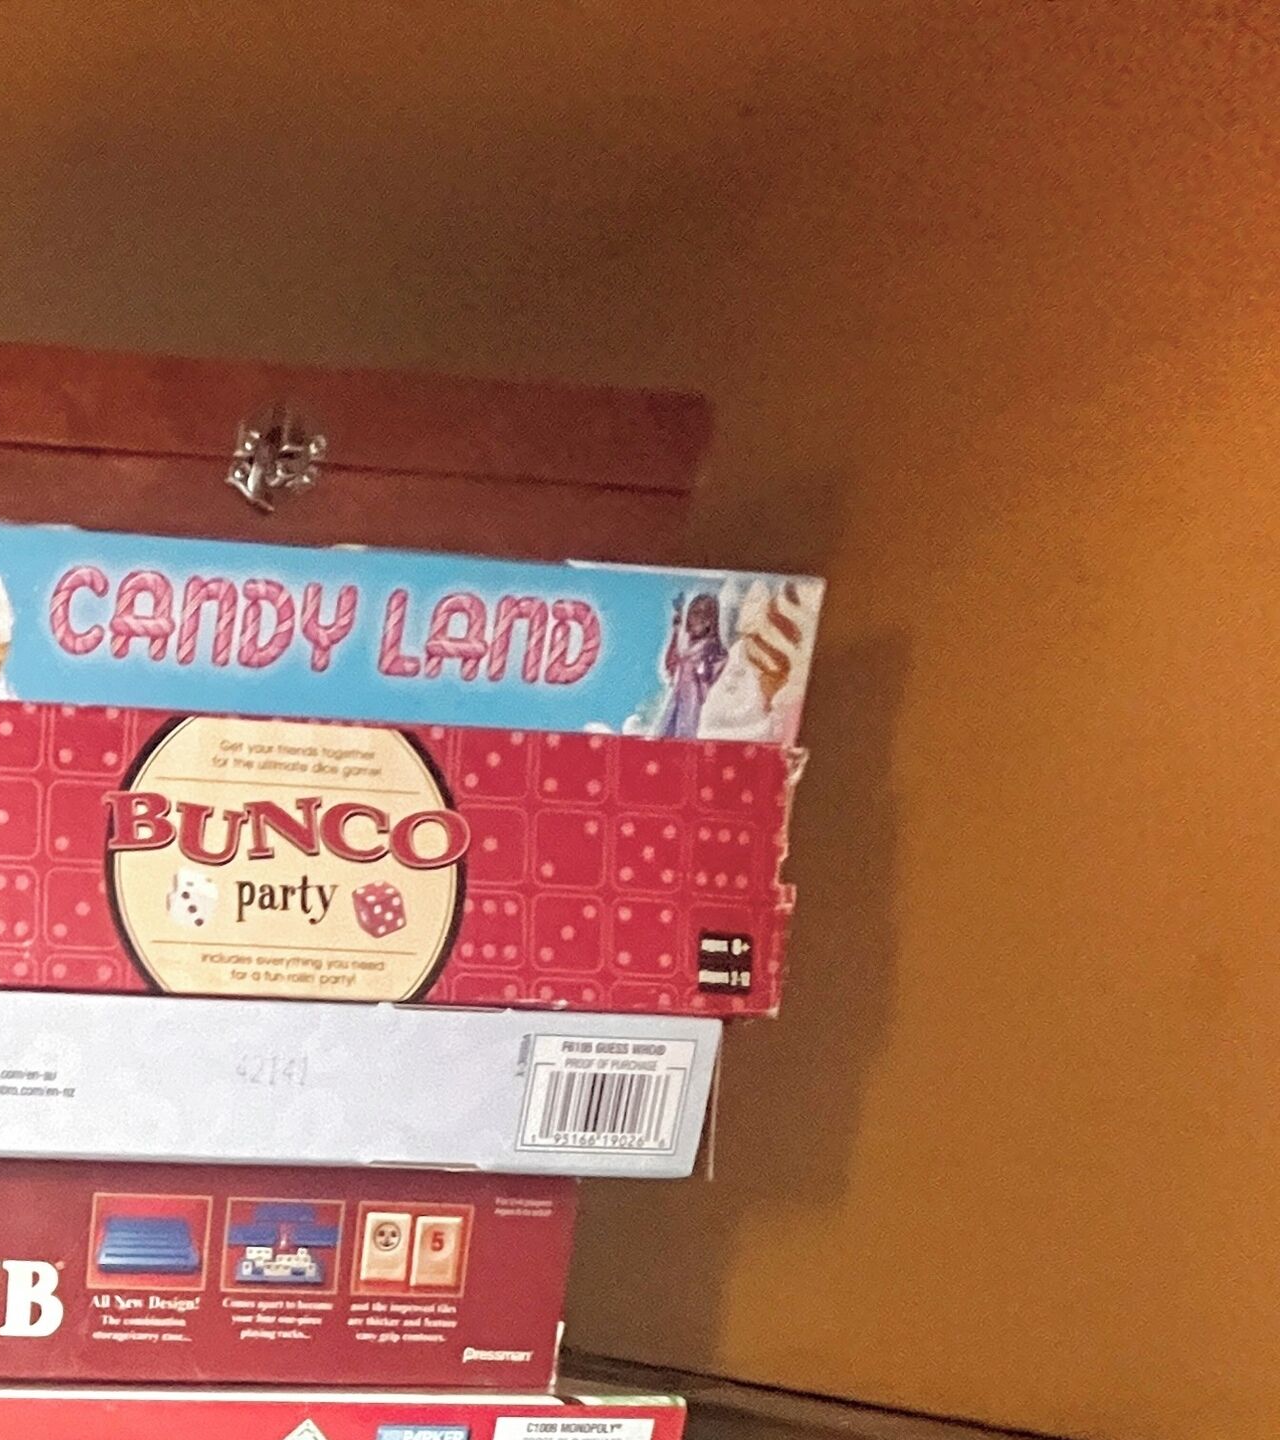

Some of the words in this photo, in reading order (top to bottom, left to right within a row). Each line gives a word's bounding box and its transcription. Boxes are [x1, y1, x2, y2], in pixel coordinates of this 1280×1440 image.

[49, 563, 359, 674] CANDY
[377, 586, 601, 686] LAND
[104, 791, 472, 871] BUNCO
[235, 875, 339, 927] party
[564, 1057, 595, 1070] PROOF
[597, 1058, 609, 1070] OF
[595, 1042, 630, 1055] GUESS
[553, 1134, 596, 1146] 95166
